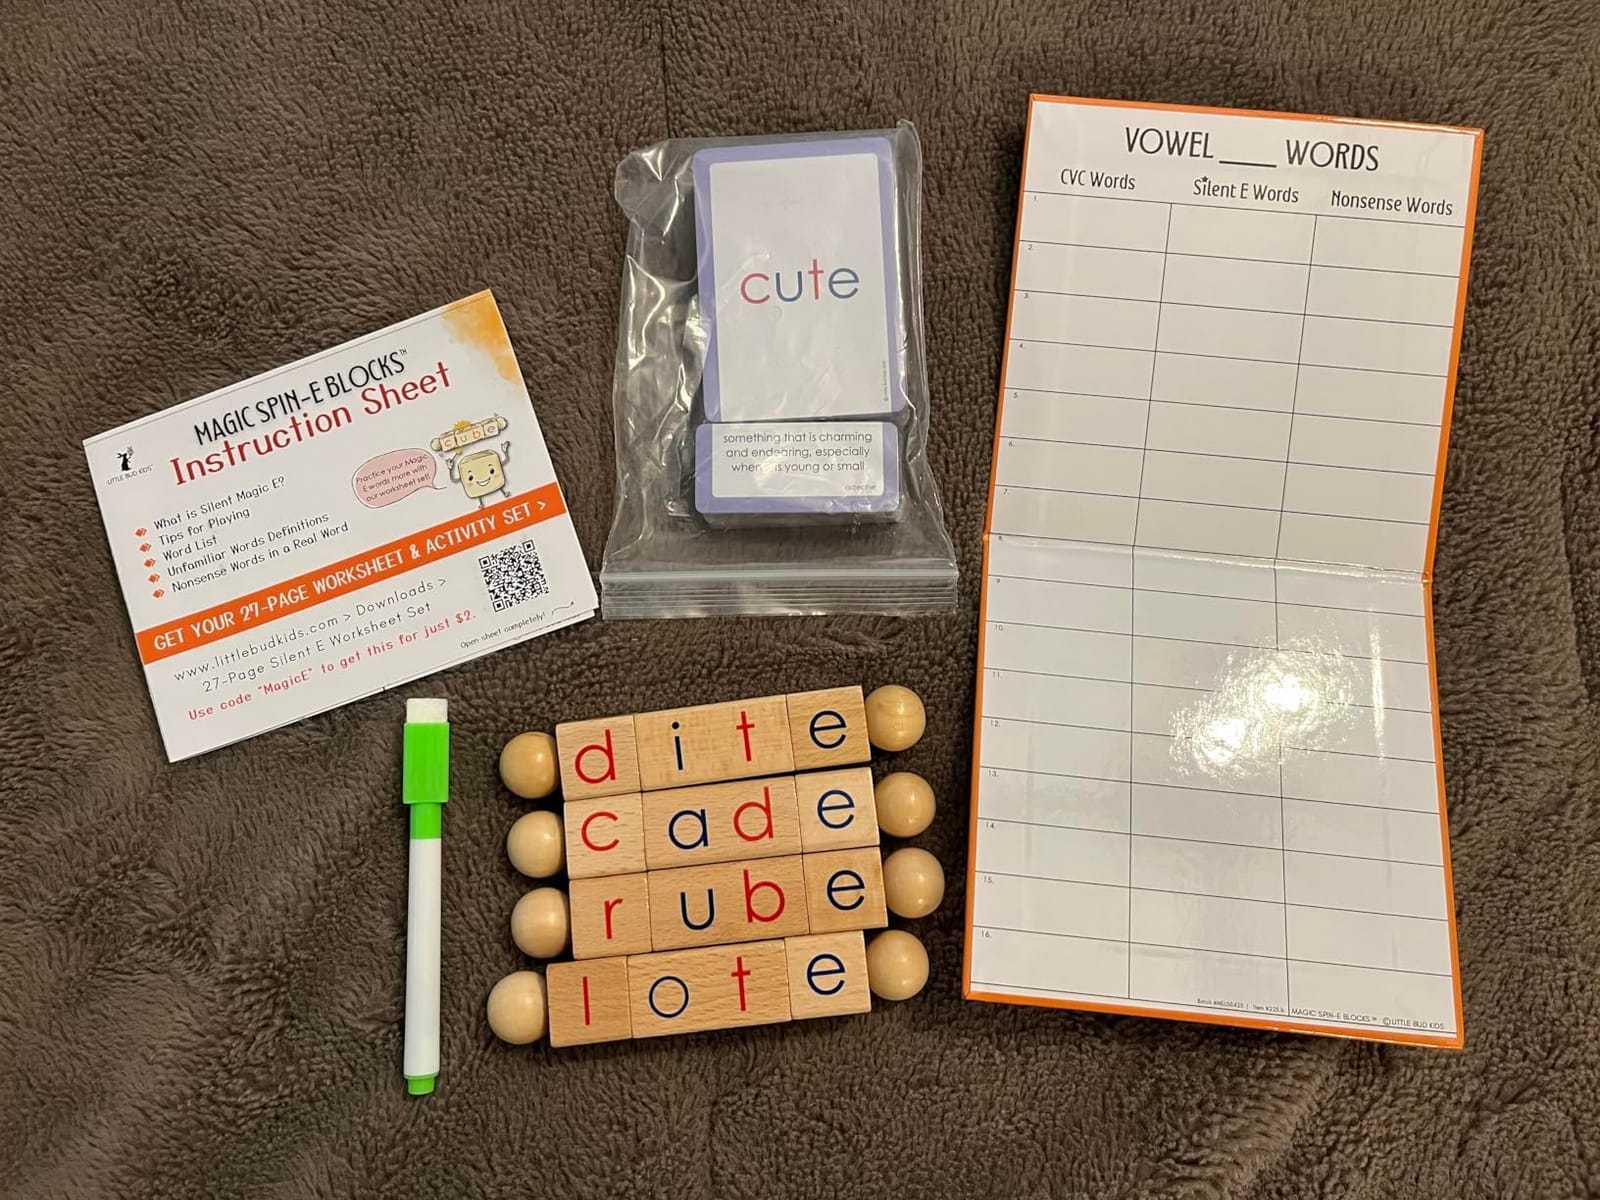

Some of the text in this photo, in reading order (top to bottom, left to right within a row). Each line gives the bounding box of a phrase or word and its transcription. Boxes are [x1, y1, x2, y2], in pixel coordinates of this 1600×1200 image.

[1124, 126, 1380, 172] VOWEL WORDS
[1060, 168, 1136, 191] CVC Words
[1192, 175, 1300, 204] Silent E Words
[1331, 190, 1454, 217] Nonsense Words
[740, 258, 860, 305] cute
[170, 361, 451, 485] Instruction Sheet
[194, 406, 256, 446] MAGIC
[256, 381, 324, 422] SPIN-E
[444, 426, 496, 445] cube
[723, 432, 872, 445] something that is charming
[726, 448, 748, 458] and
[815, 446, 870, 459] especially
[356, 454, 428, 484] Practice your Magic
[369, 478, 391, 490] words
[392, 471, 411, 482] more
[412, 464, 428, 474] with
[784, 463, 821, 474] young
[823, 463, 834, 472] or
[836, 461, 865, 472] small
[153, 476, 285, 531] What is Silent Magic E?
[366, 493, 378, 502] our
[380, 479, 416, 497] worksheet
[158, 507, 250, 546] Tips for Playing
[167, 513, 329, 577] Unfamiliar Words Definitions
[162, 535, 218, 561] Word List
[171, 522, 349, 592] Nonsense Words in a Real Word
[153, 629, 186, 652] GET
[191, 612, 236, 638] YOUR
[239, 586, 310, 621] 27-PAGE
[312, 549, 404, 595] WORKSHEET
[409, 543, 420, 560] &
[426, 514, 496, 555] ACTIVITY
[503, 502, 532, 525] SET
[174, 617, 338, 681] www.littlebudkids.com
[356, 576, 434, 617] Downloads
[202, 602, 431, 693] 27-Page Silent E Worksheet Set
[460, 611, 547, 649] Open sheet completely!
[188, 706, 214, 721] Use
[220, 692, 252, 711] code
[321, 663, 335, 674] to
[340, 651, 361, 669] get
[367, 639, 393, 657] this
[399, 629, 418, 646] for
[424, 617, 450, 639] just
[456, 610, 476, 625] $2.
[574, 709, 847, 784] dite
[581, 786, 855, 852] cade
[603, 869, 865, 940] rube
[1291, 1008, 1315, 1018] MAGIC
[1318, 1010, 1342, 1020] SPIN-E
[1412, 1020, 1428, 1028] BUD
[1429, 1021, 1445, 1030] KIDS
